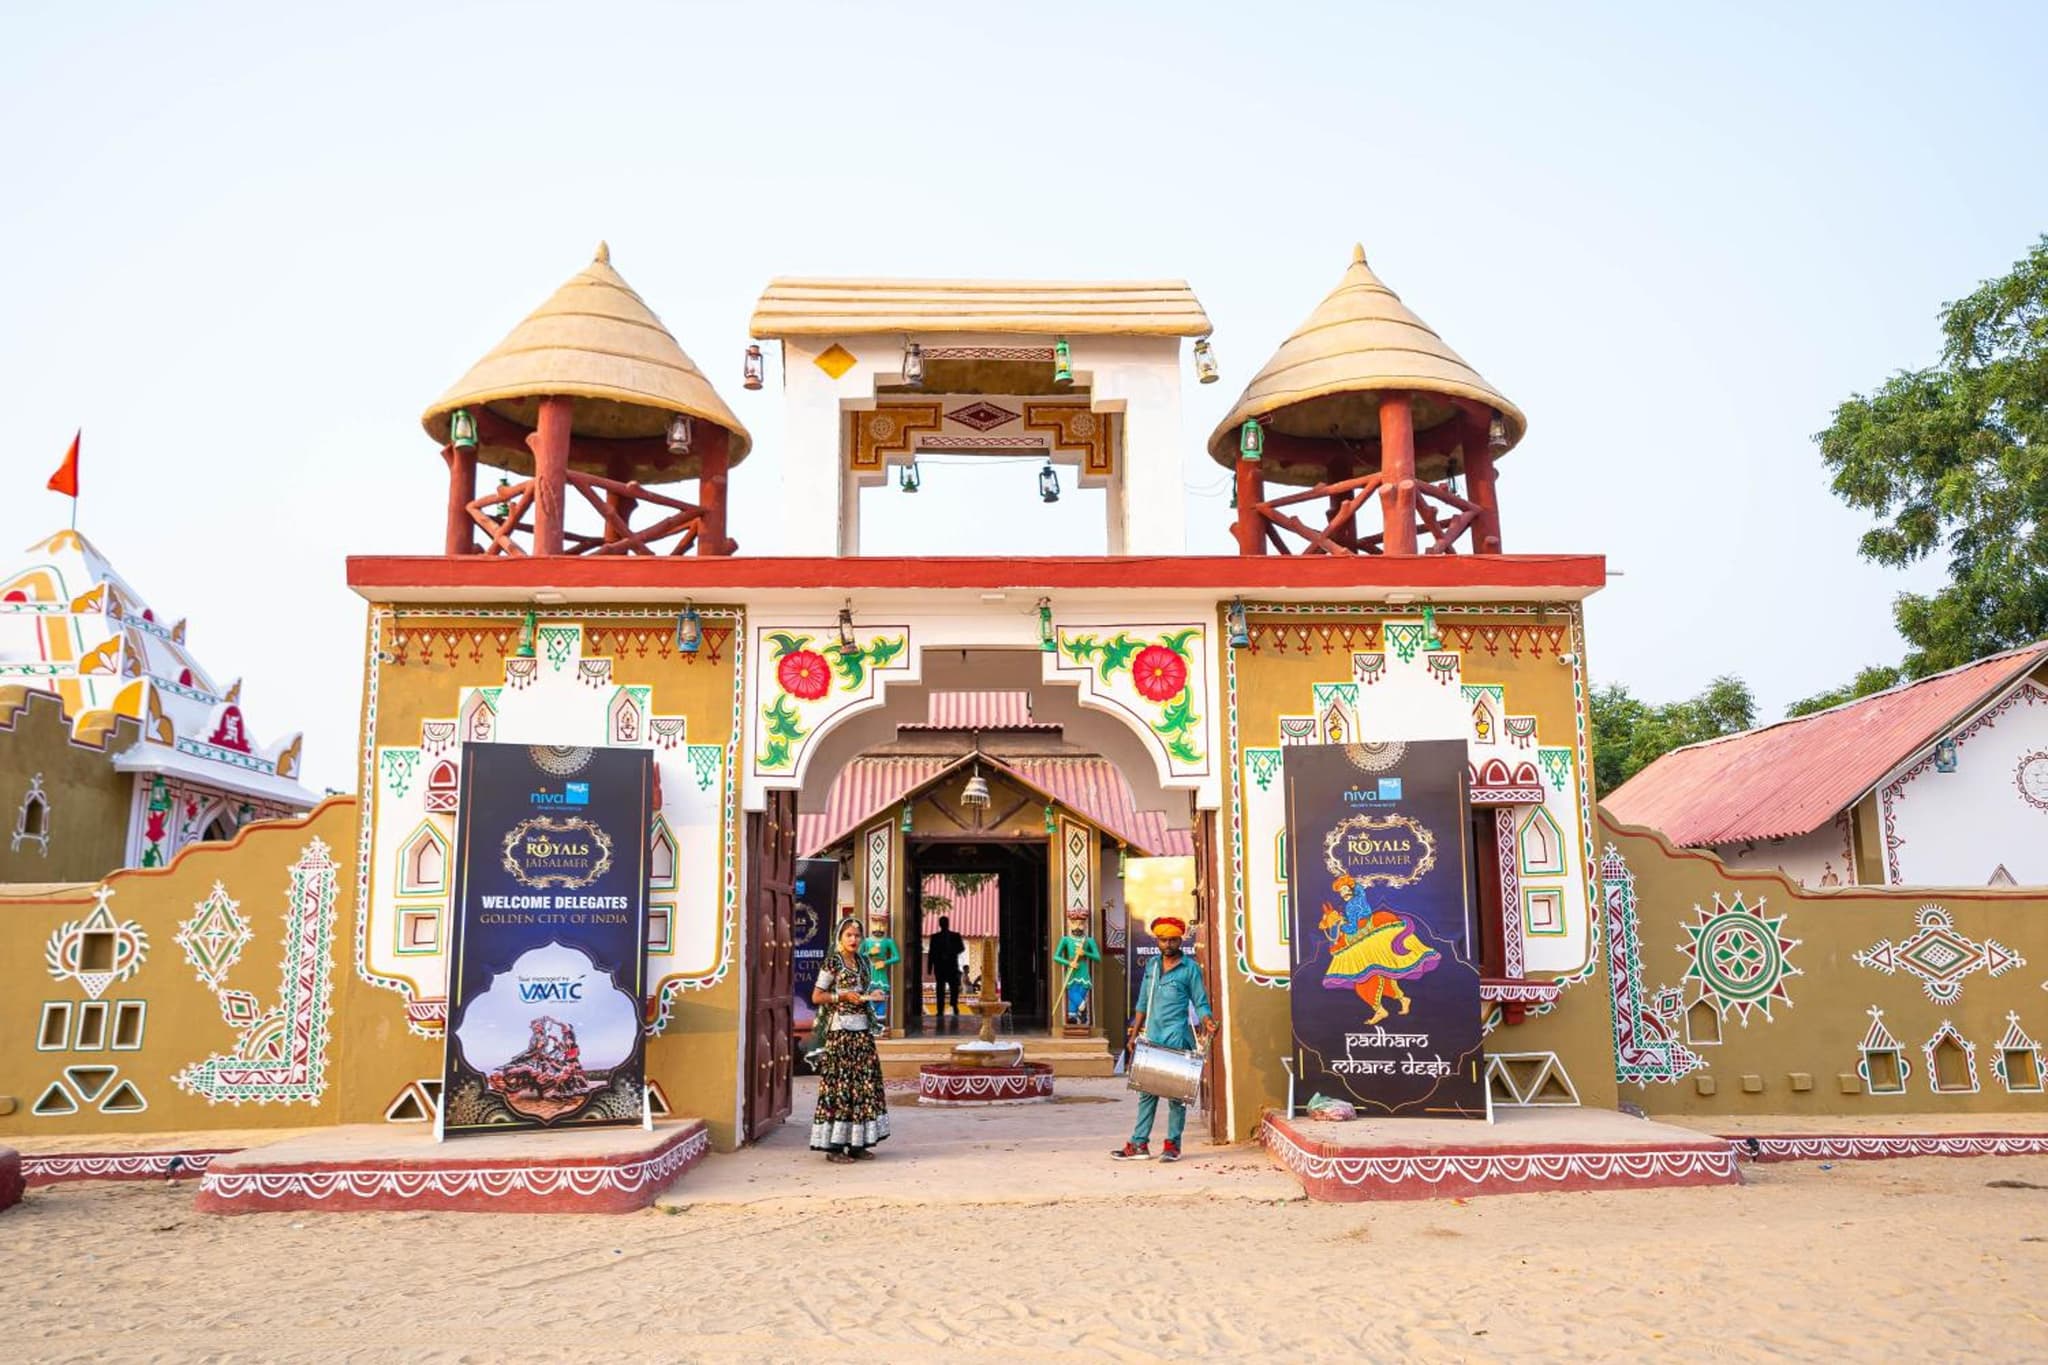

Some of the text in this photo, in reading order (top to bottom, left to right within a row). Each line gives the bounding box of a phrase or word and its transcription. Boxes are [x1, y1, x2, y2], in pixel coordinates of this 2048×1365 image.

[530, 786, 564, 804] niva
[1343, 785, 1377, 801] niva
[526, 841, 590, 858] ROYALS
[1348, 840, 1411, 855] ROYALS
[525, 858, 589, 869] JAISALMER
[1347, 855, 1412, 866] JAISALMER
[482, 896, 628, 909] WELCOME DELEGATES
[480, 913, 628, 924] GOLDEN CITY OF INDIA
[1345, 1025, 1429, 1054] padharo
[1331, 1052, 1451, 1078] mhare desh
